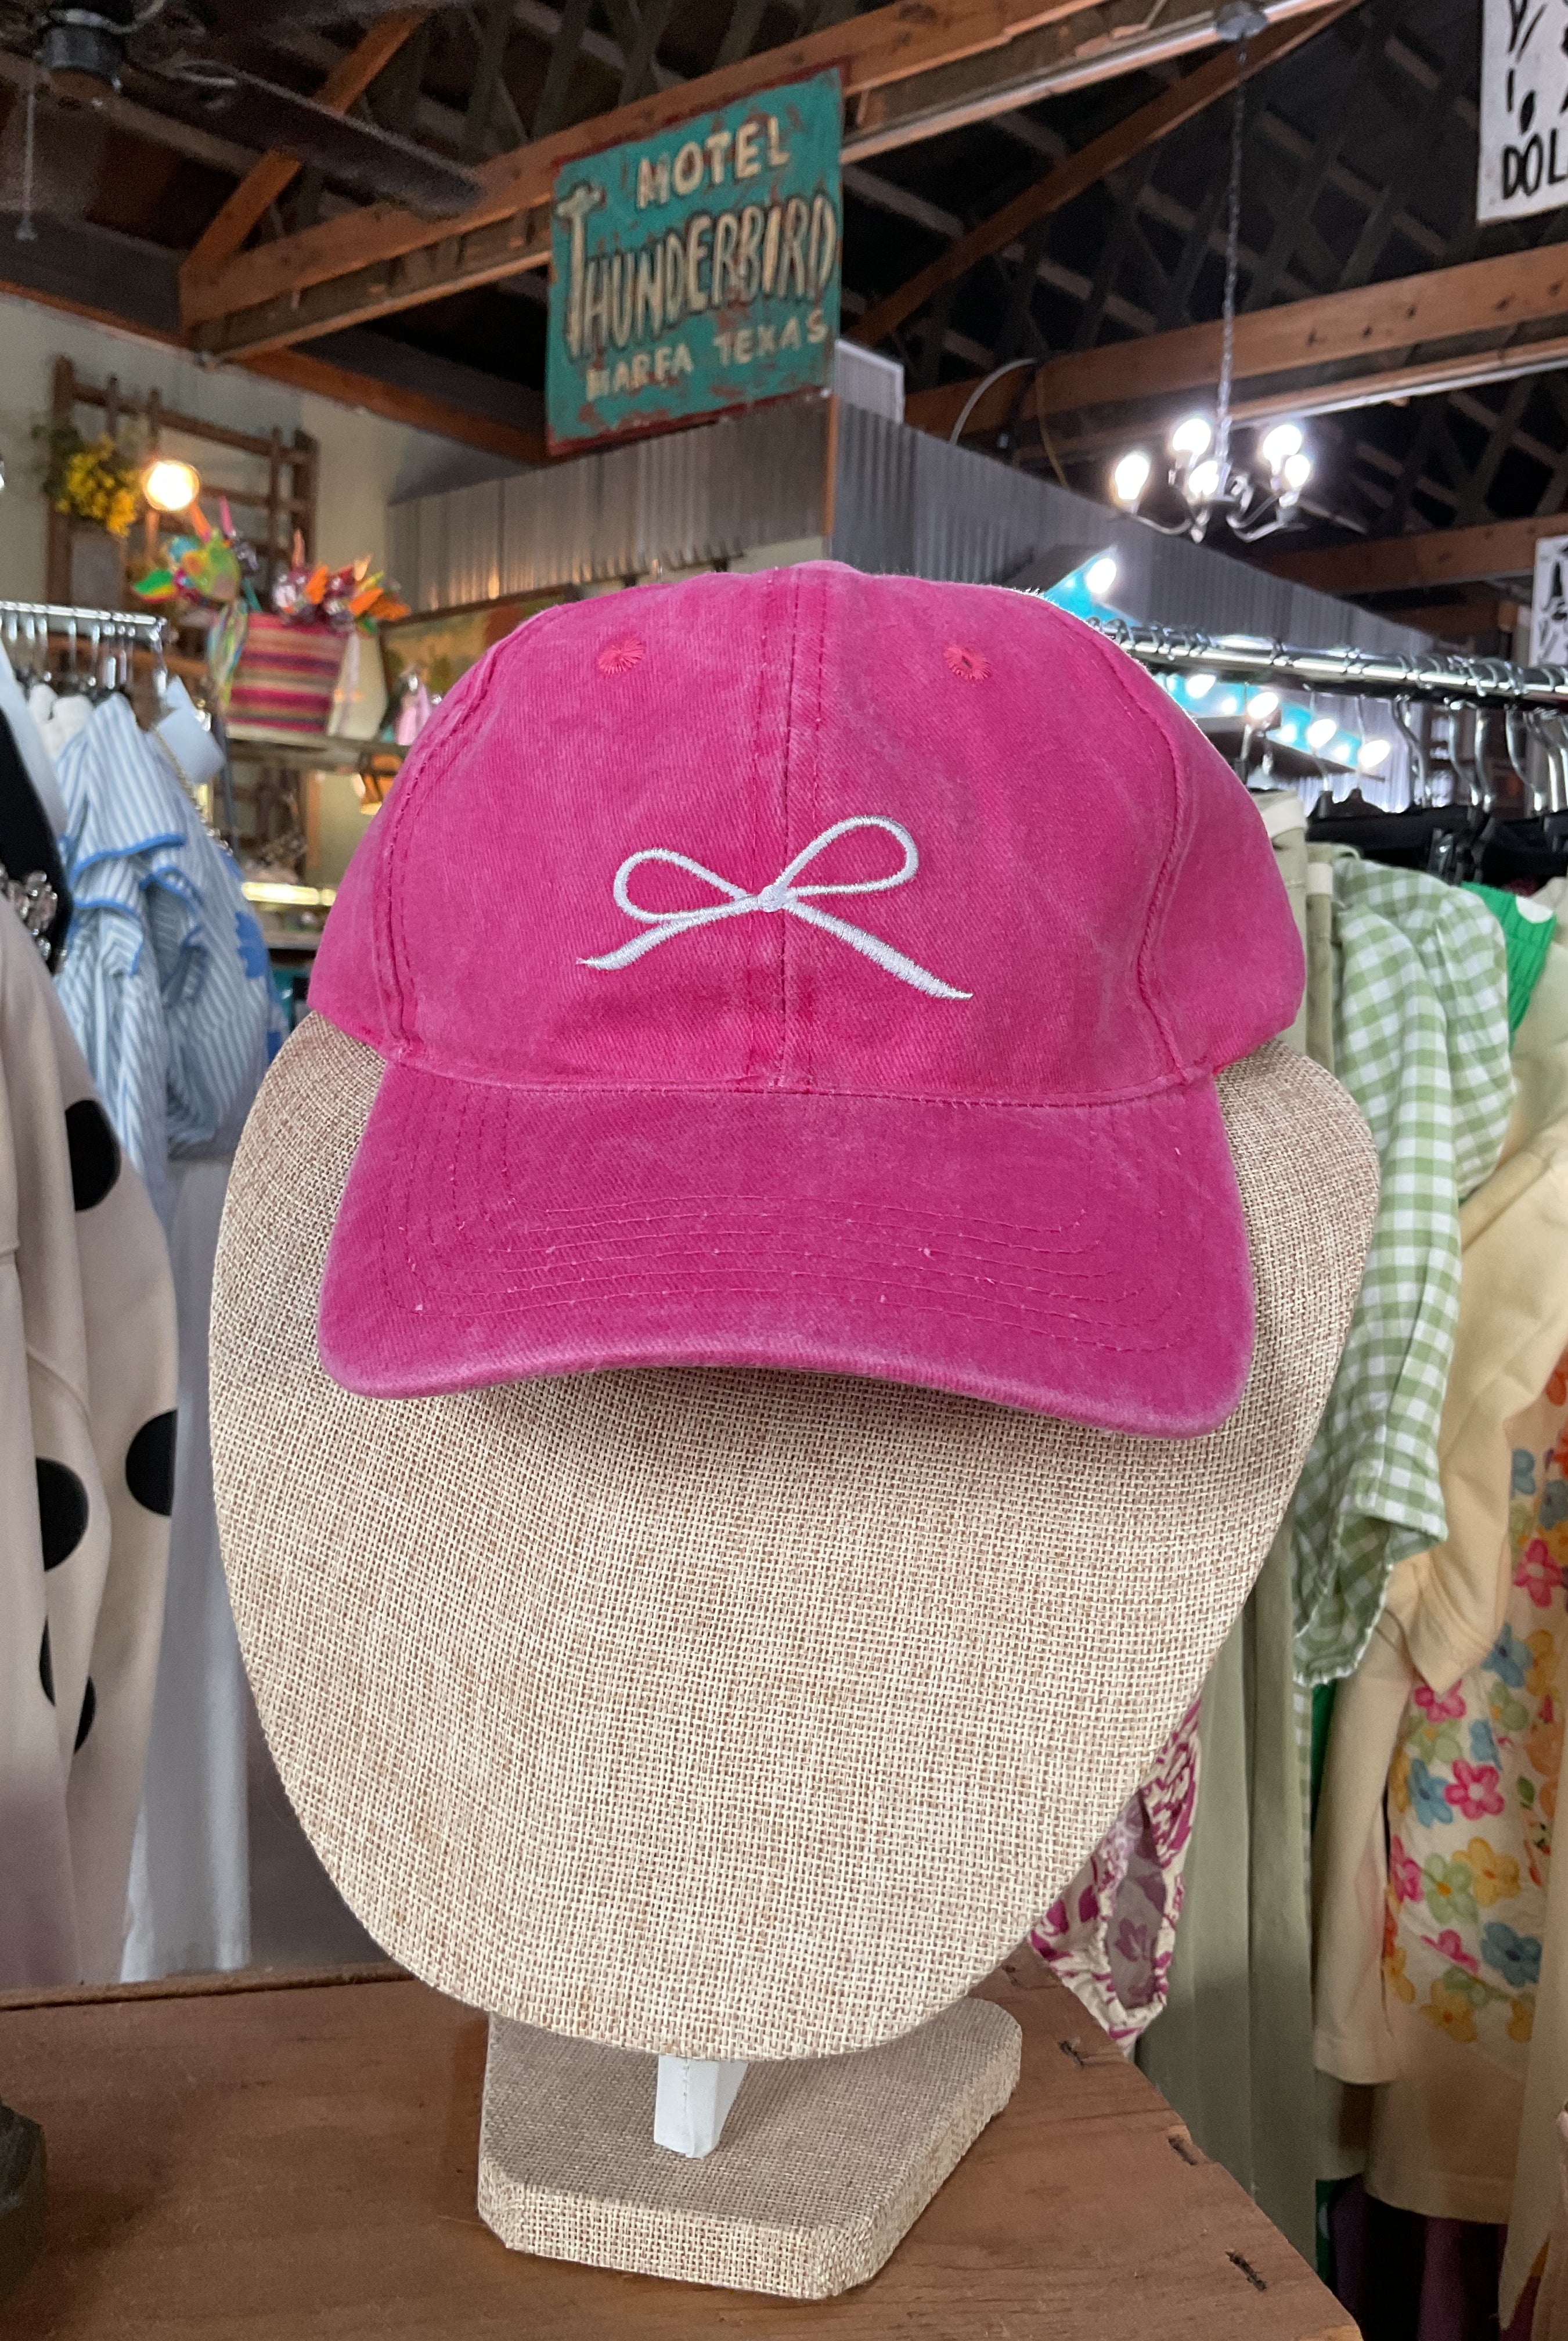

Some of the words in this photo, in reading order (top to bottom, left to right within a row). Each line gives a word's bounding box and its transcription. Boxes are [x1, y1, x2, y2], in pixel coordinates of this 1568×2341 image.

[637, 117, 790, 209] MOTEL
[556, 185, 837, 358] THUNDERBIRD
[586, 343, 694, 402] MARFA
[713, 309, 828, 367] TEXAS
